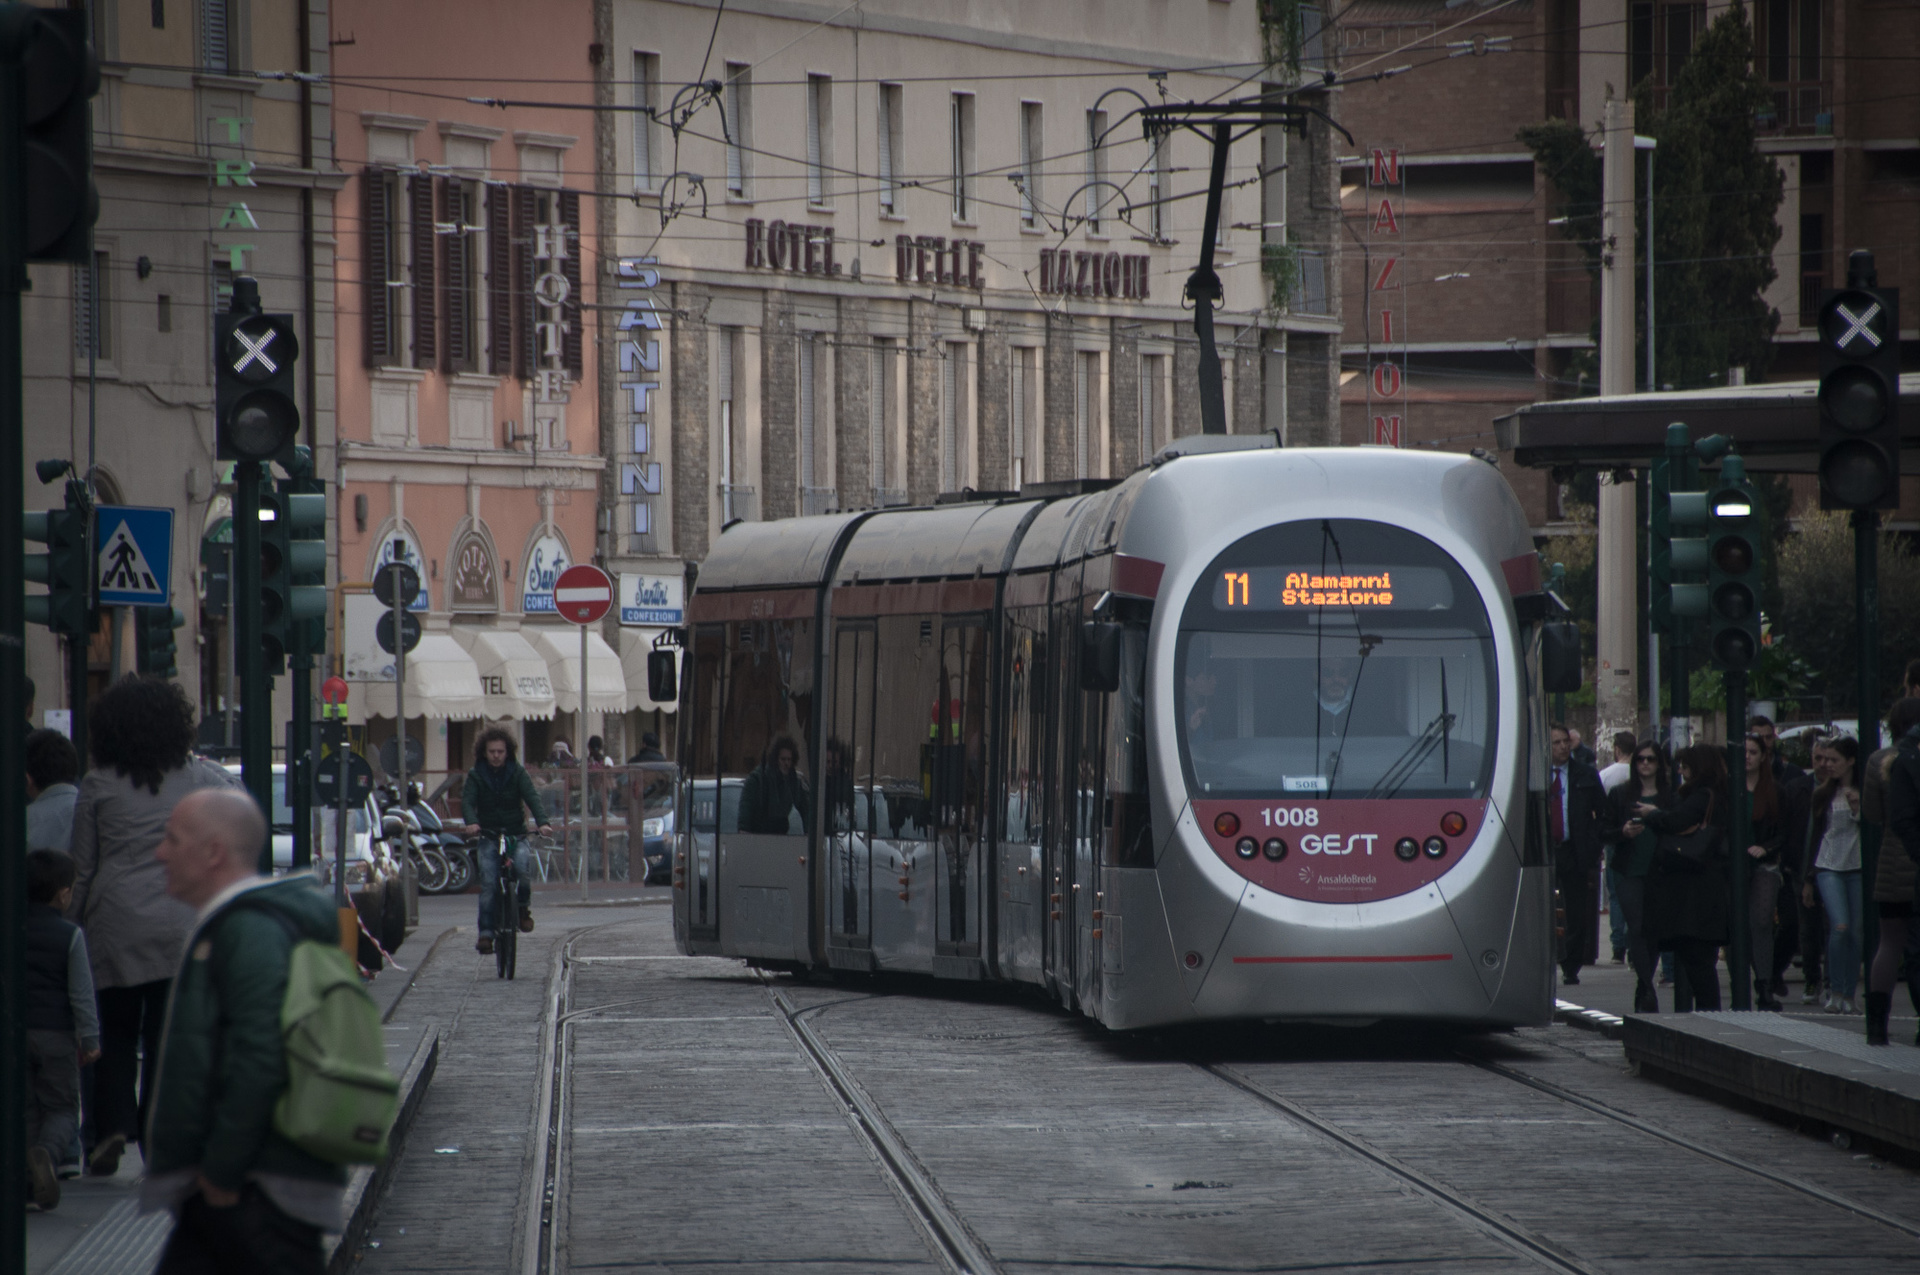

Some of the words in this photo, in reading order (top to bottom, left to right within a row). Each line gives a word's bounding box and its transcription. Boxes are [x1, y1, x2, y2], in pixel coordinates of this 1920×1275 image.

[745, 218, 842, 276] HOTEL
[896, 234, 986, 289] DELLE
[1040, 248, 1150, 300] NAZIONI
[534, 224, 571, 451] HOTEL
[617, 256, 663, 534] SANTINI
[456, 545, 491, 593] HOTEL
[636, 577, 668, 606] Santini
[1224, 572, 1249, 606] T1
[1285, 572, 1391, 589] Alamanni
[1282, 589, 1393, 606] Stazione
[627, 610, 676, 622] CONFEZIONI
[480, 675, 506, 695] TEL
[1260, 807, 1320, 827] 1008
[1300, 833, 1379, 855] GEST
[1316, 873, 1378, 885] AnsaldoBreda
